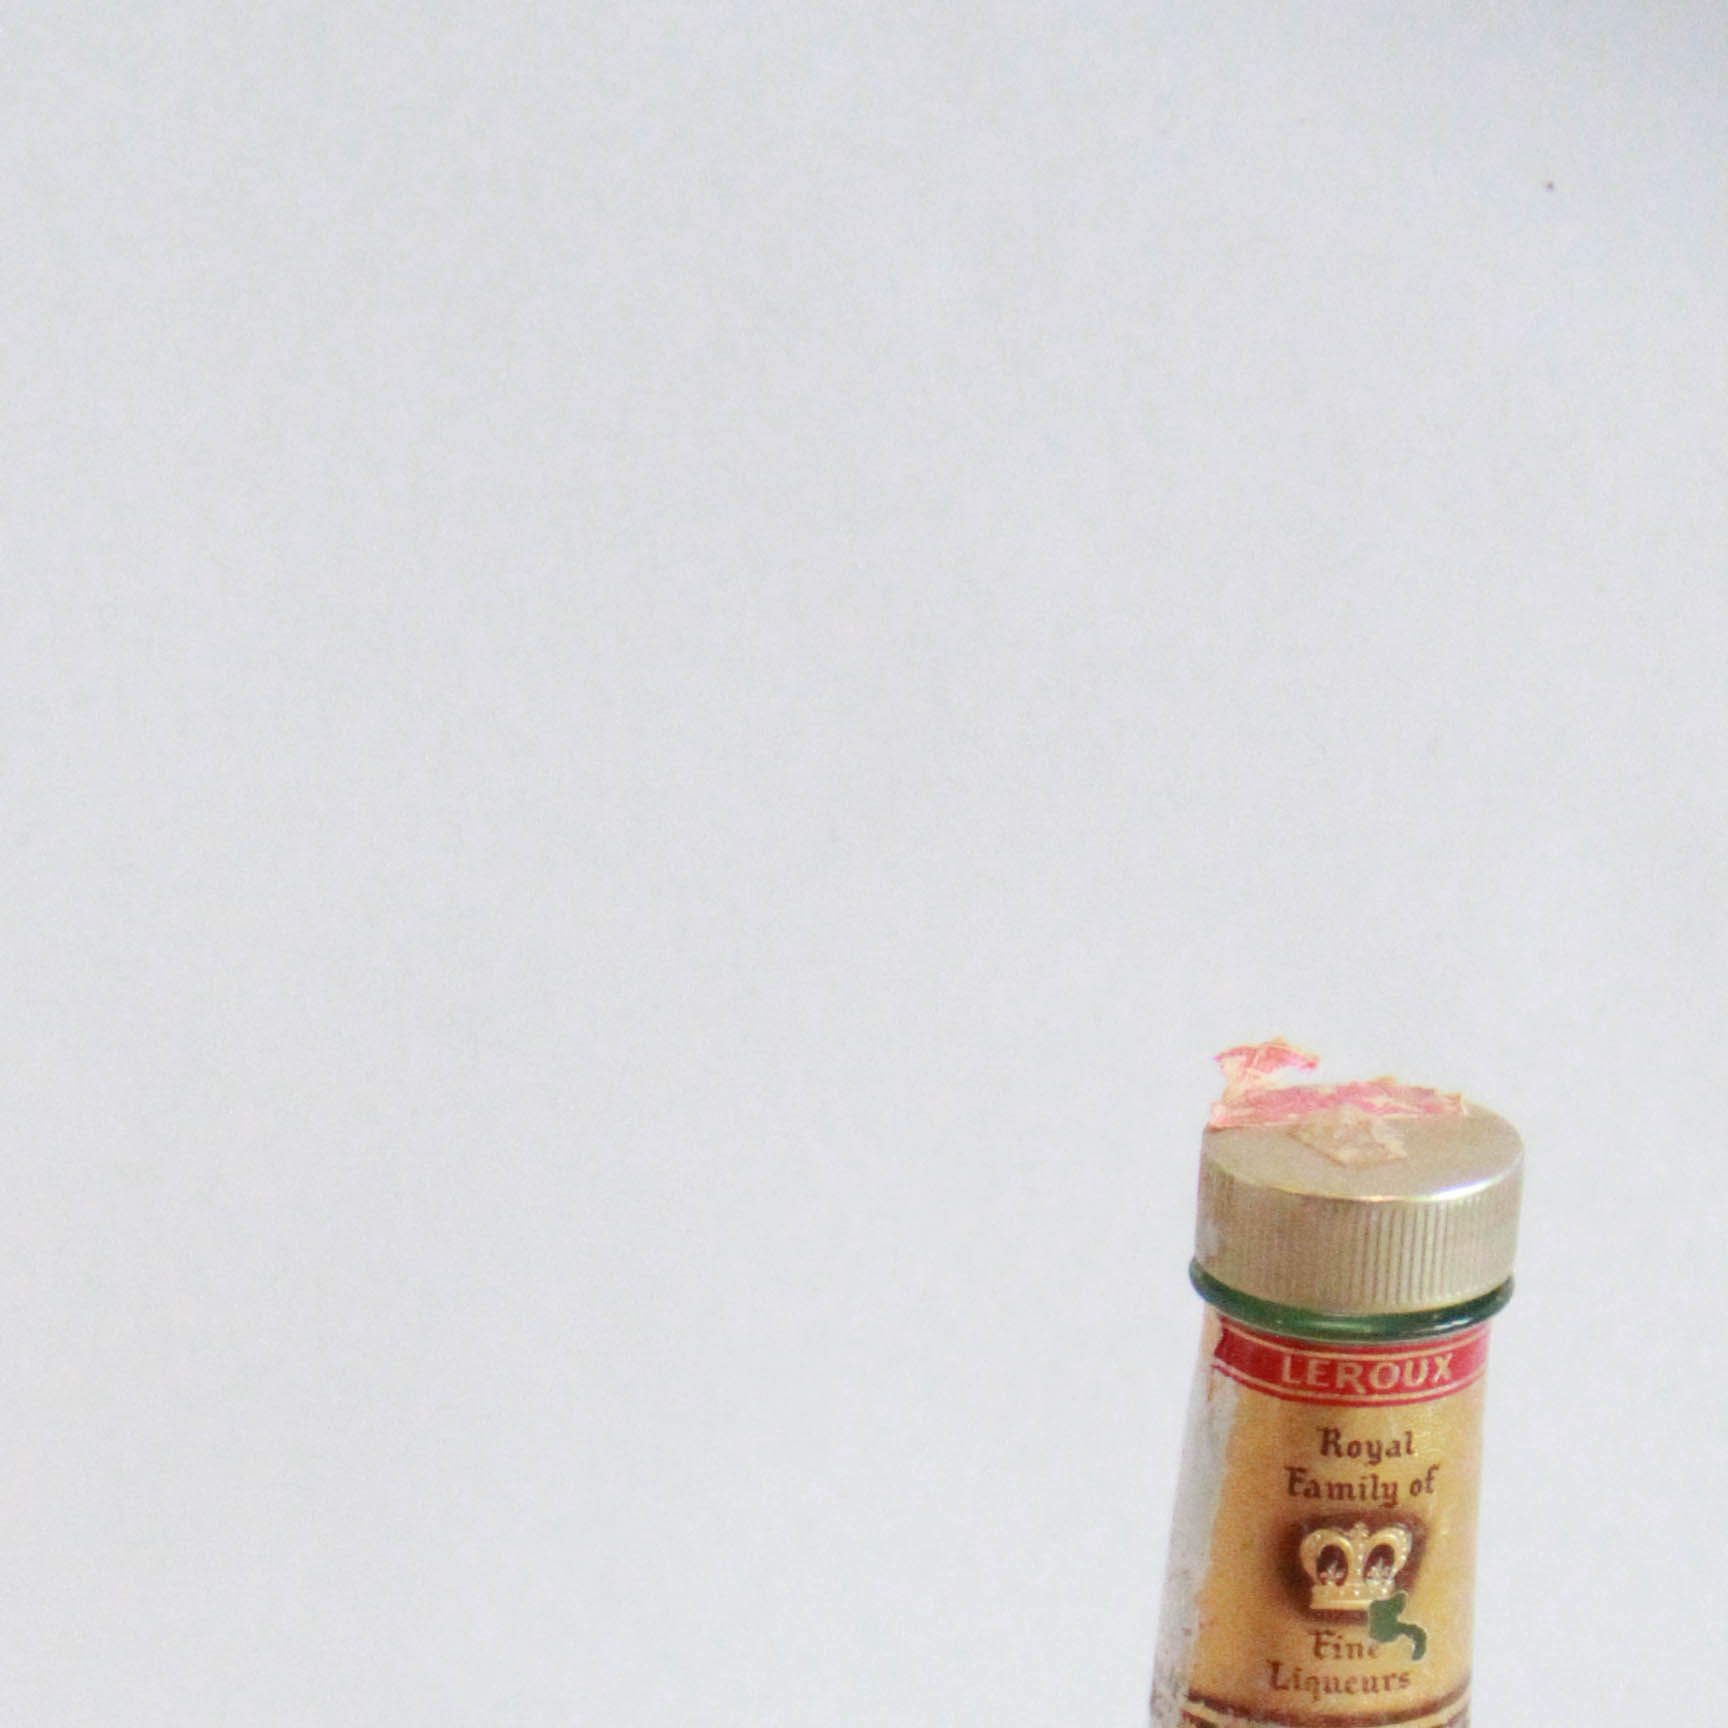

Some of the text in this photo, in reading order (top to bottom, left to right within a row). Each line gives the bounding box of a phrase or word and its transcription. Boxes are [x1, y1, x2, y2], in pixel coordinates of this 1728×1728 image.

[1281, 1350, 1453, 1395] LEROUX
[1317, 1428, 1415, 1459] Royal
[1284, 1462, 1440, 1508] Family of
